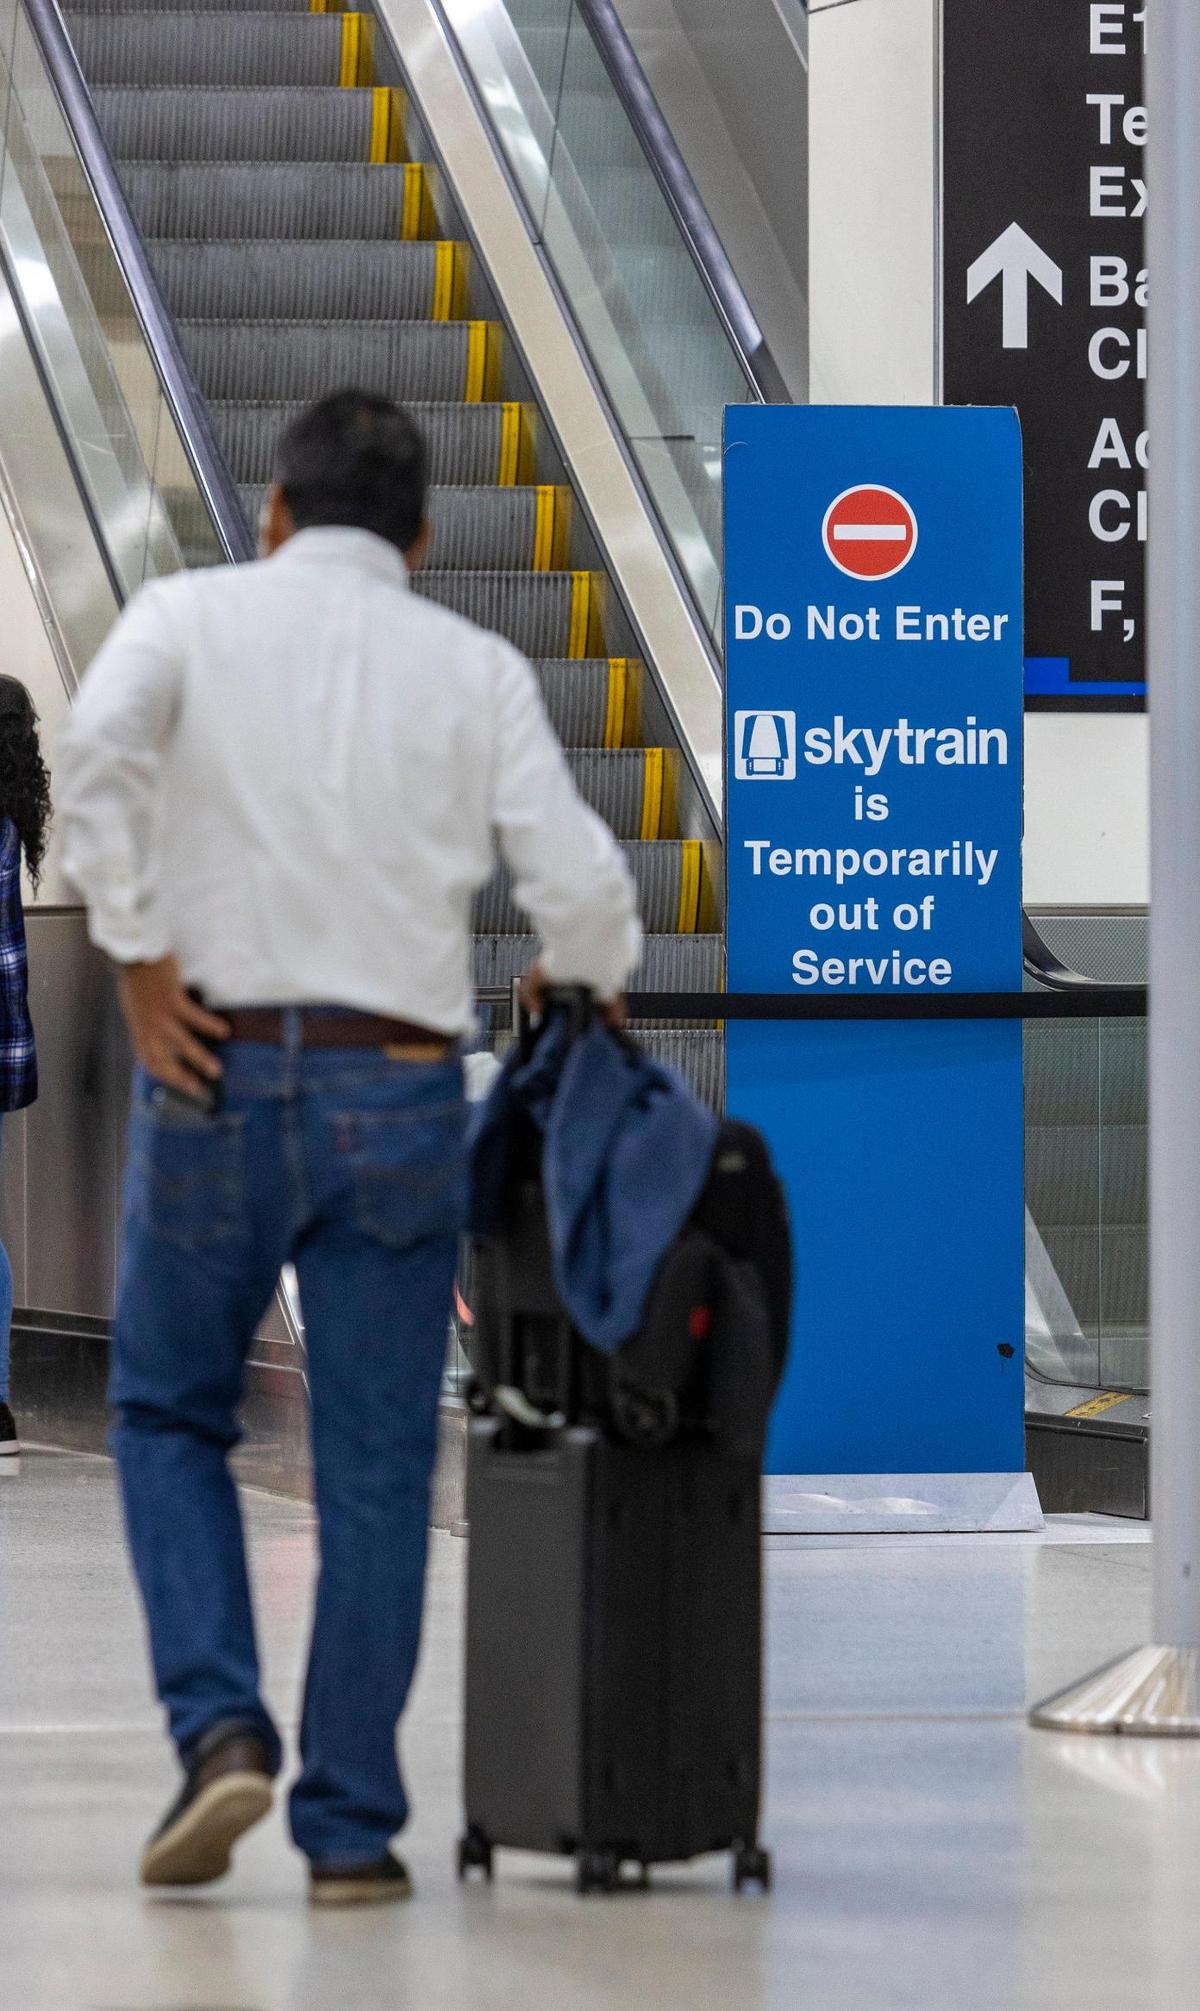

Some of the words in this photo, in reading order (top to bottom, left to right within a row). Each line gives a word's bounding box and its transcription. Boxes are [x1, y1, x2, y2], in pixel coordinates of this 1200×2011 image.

[1085, 93, 1149, 146] Te
[734, 604, 791, 641] Do
[807, 605, 880, 641] Not
[895, 605, 1009, 642] Enter
[1090, 579, 1135, 643] F,
[803, 715, 1008, 776] skytrain
[854, 785, 889, 821] is
[743, 840, 999, 886] Temporarily
[809, 897, 879, 931] out
[892, 895, 935, 931] of
[791, 949, 952, 986] Service
